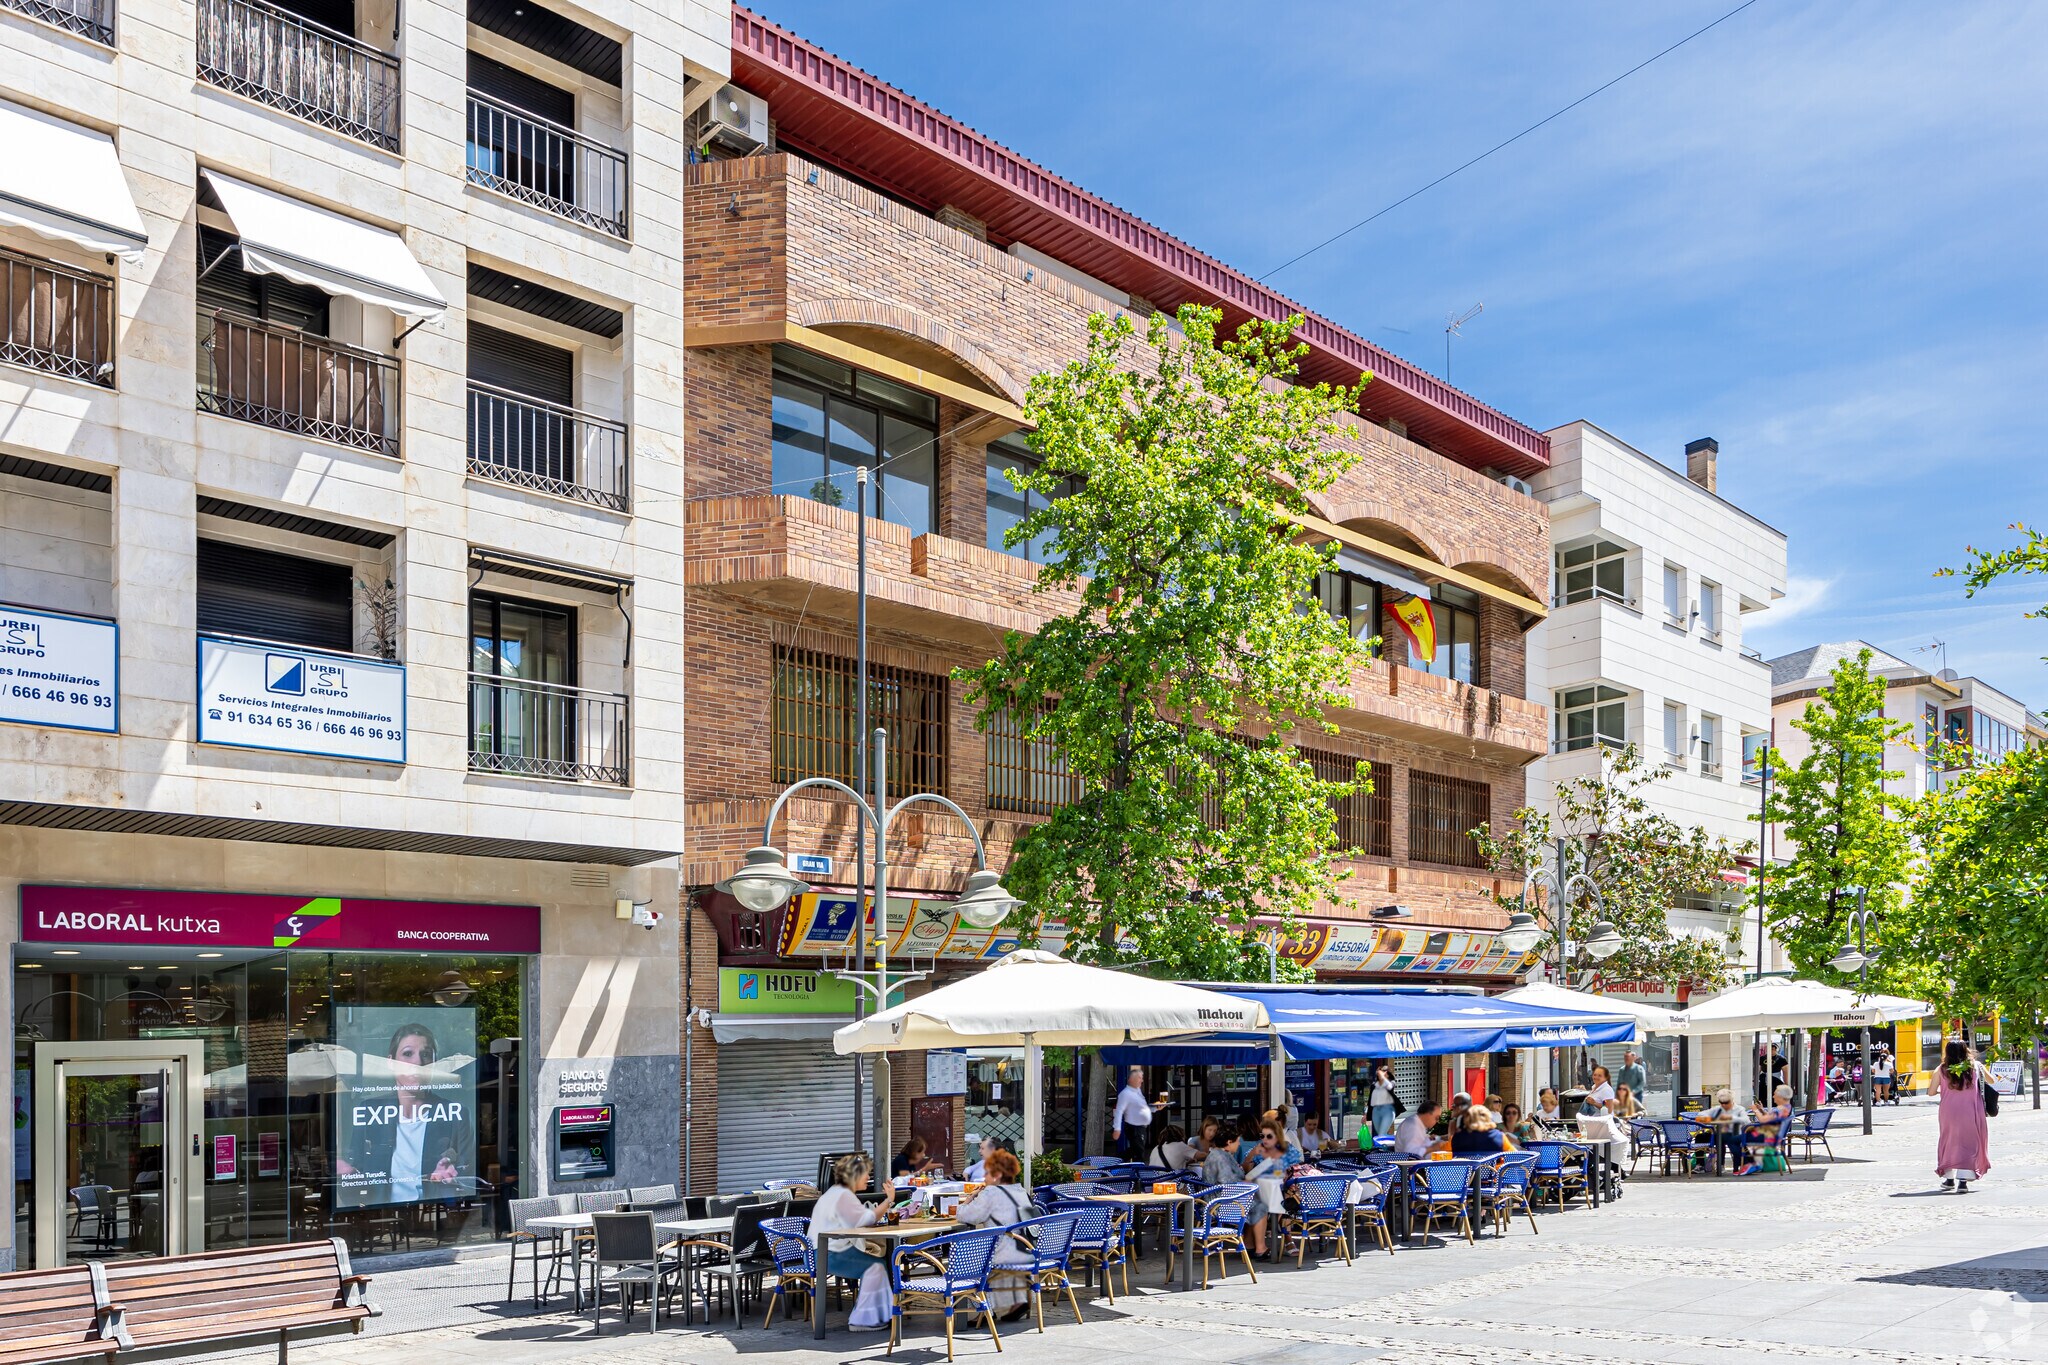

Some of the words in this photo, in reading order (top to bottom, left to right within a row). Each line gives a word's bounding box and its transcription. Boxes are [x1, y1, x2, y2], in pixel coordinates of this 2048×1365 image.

[17, 668, 100, 686] Inmobiliarios
[310, 664, 341, 674] URBI
[12, 685, 40, 700] 666
[46, 690, 65, 702] 46
[70, 692, 88, 705] 96
[93, 696, 112, 708] 93
[310, 688, 348, 698] GRUPO
[218, 694, 268, 708] Servicios
[271, 700, 324, 714] Integrales
[326, 708, 392, 722] Inmobiliarios
[228, 711, 243, 722] 91
[248, 714, 272, 726] 634
[277, 717, 292, 728] 65
[297, 719, 312, 731] 36
[324, 722, 346, 735] 666
[350, 726, 365, 737] 46
[368, 728, 383, 740] 96
[387, 730, 402, 742] 93
[38, 910, 152, 931] LABORAL
[158, 915, 220, 933] kutxa
[398, 930, 428, 940] BANCA
[430, 931, 490, 942] COOPERATIVA
[1288, 930, 1320, 955] 33
[1328, 940, 1370, 954] ASESORÍA
[766, 974, 816, 992] HOFU
[1606, 979, 1637, 993] General
[1197, 1009, 1243, 1019] Mahou
[1385, 1032, 1424, 1052] ORZAN
[1531, 1026, 1559, 1041] Cocina
[1559, 1025, 1589, 1045] Gallega
[1833, 1043, 1843, 1052] El
[562, 1071, 595, 1080] BANCA
[597, 1070, 604, 1079] &
[561, 1082, 607, 1092] SEGUROS
[352, 1103, 462, 1126] EXPLICAR
